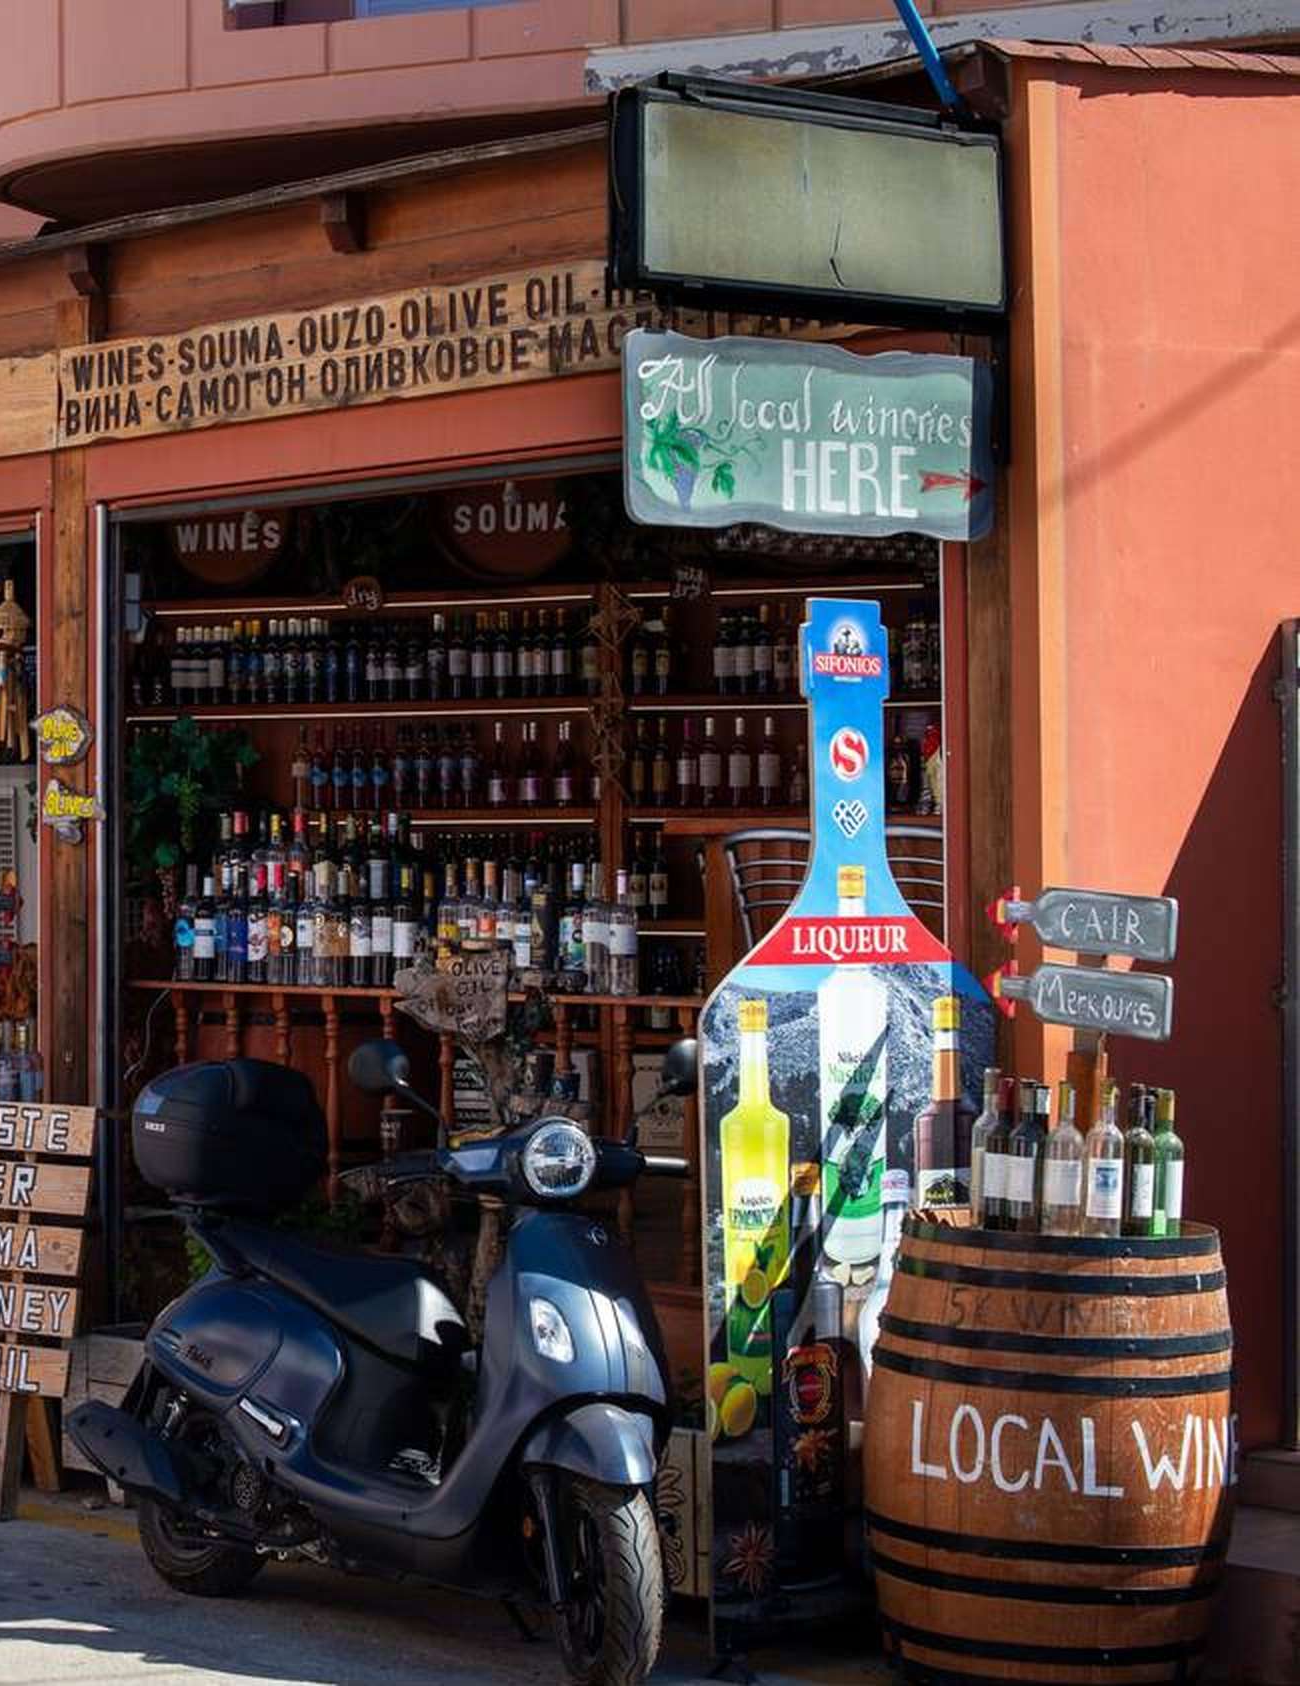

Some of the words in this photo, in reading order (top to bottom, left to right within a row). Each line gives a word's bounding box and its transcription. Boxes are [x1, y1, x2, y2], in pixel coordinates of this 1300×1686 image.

[72, 343, 165, 393] WINES
[178, 322, 284, 374] SOUMA
[298, 305, 385, 353] OUZO
[403, 281, 509, 338] OLIVE
[525, 273, 587, 320] OIL
[66, 384, 141, 437] ВИНА
[156, 364, 307, 421] САМОГОН
[320, 328, 530, 398] ОЛИВКОВОЕ
[638, 353, 718, 425] All
[724, 362, 816, 435] local
[827, 387, 973, 448] wineries
[782, 439, 919, 518] HERE
[176, 519, 282, 553] WINES
[815, 655, 881, 675] SIFONIOS
[452, 959, 502, 977] OLIVE
[792, 926, 908, 959] LIQUEUR
[458, 980, 492, 996] OIL
[1037, 974, 1156, 1028] Merkouris
[911, 1401, 1124, 1498] LOCAL
[1131, 1412, 1239, 1493] WINE
